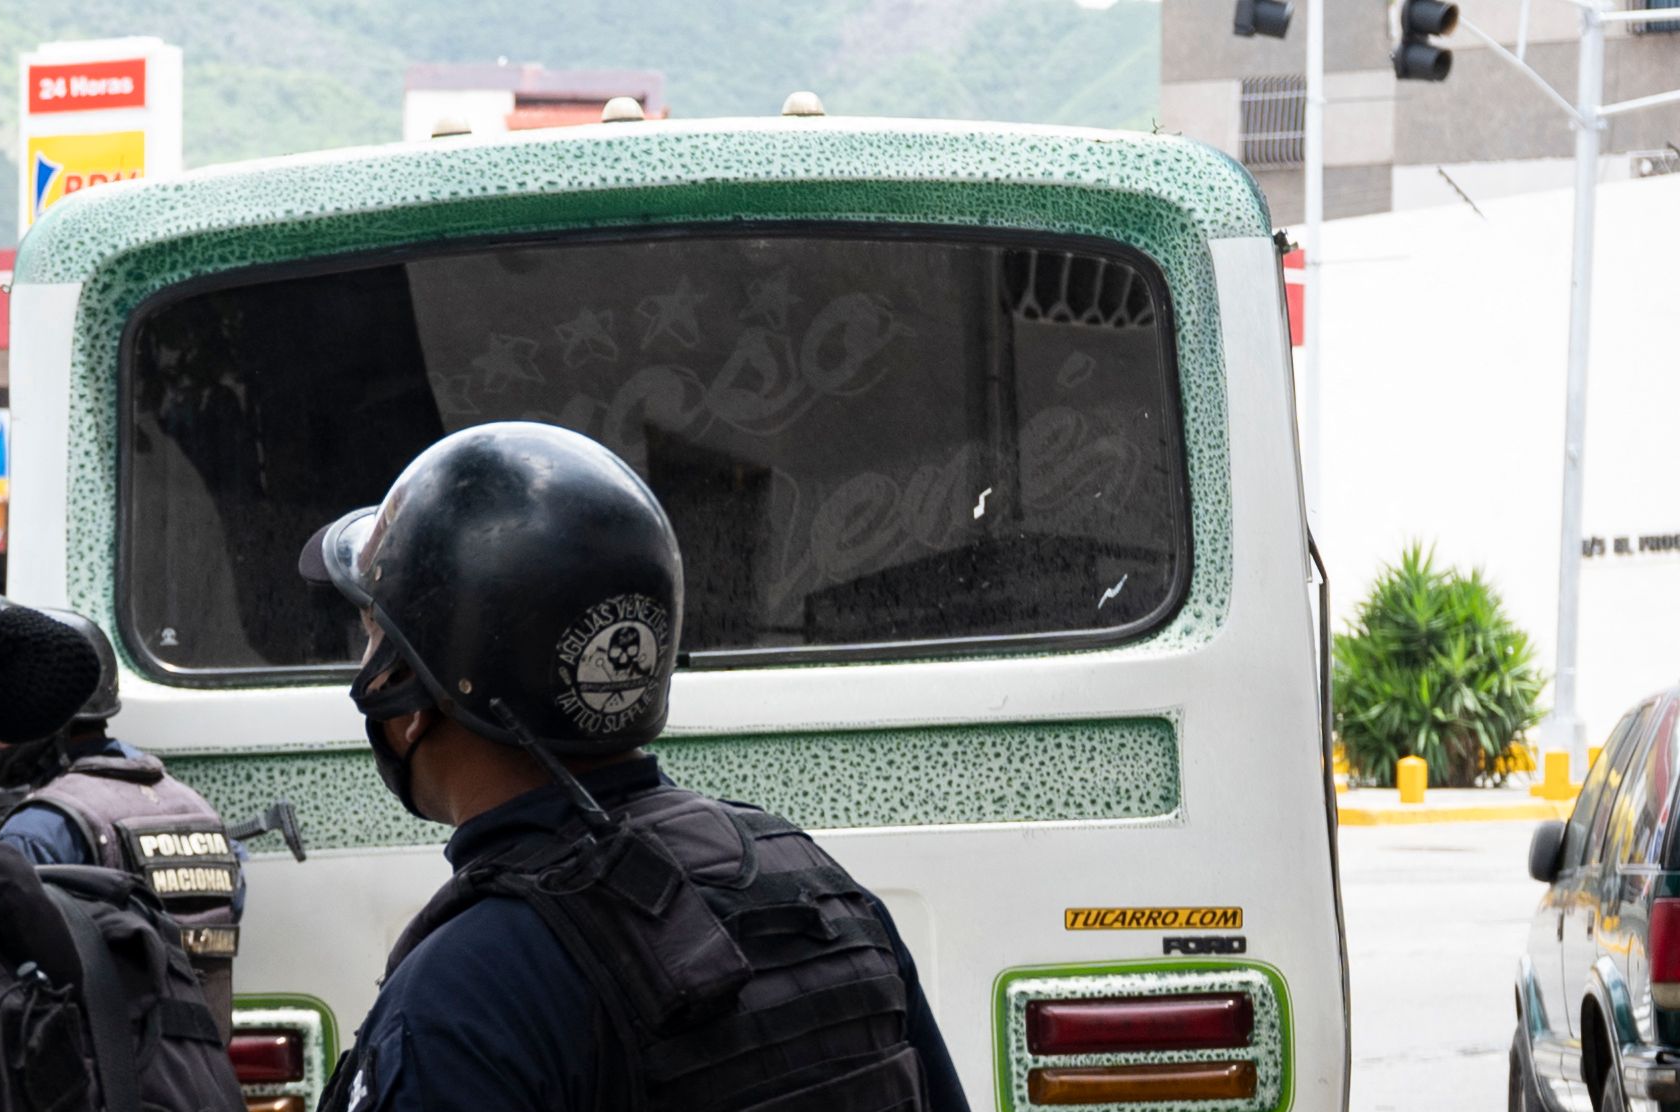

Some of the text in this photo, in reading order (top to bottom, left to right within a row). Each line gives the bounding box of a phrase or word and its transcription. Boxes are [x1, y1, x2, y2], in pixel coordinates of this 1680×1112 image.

[39, 76, 134, 100] 24 Horas
[558, 602, 615, 666] AGUJAS
[556, 687, 603, 733] TATTOO
[139, 832, 229, 857] POLICIA
[152, 867, 233, 893] NACIONAL
[1068, 909, 1239, 928] TUCARRO.COM
[1163, 936, 1247, 955] FORD
